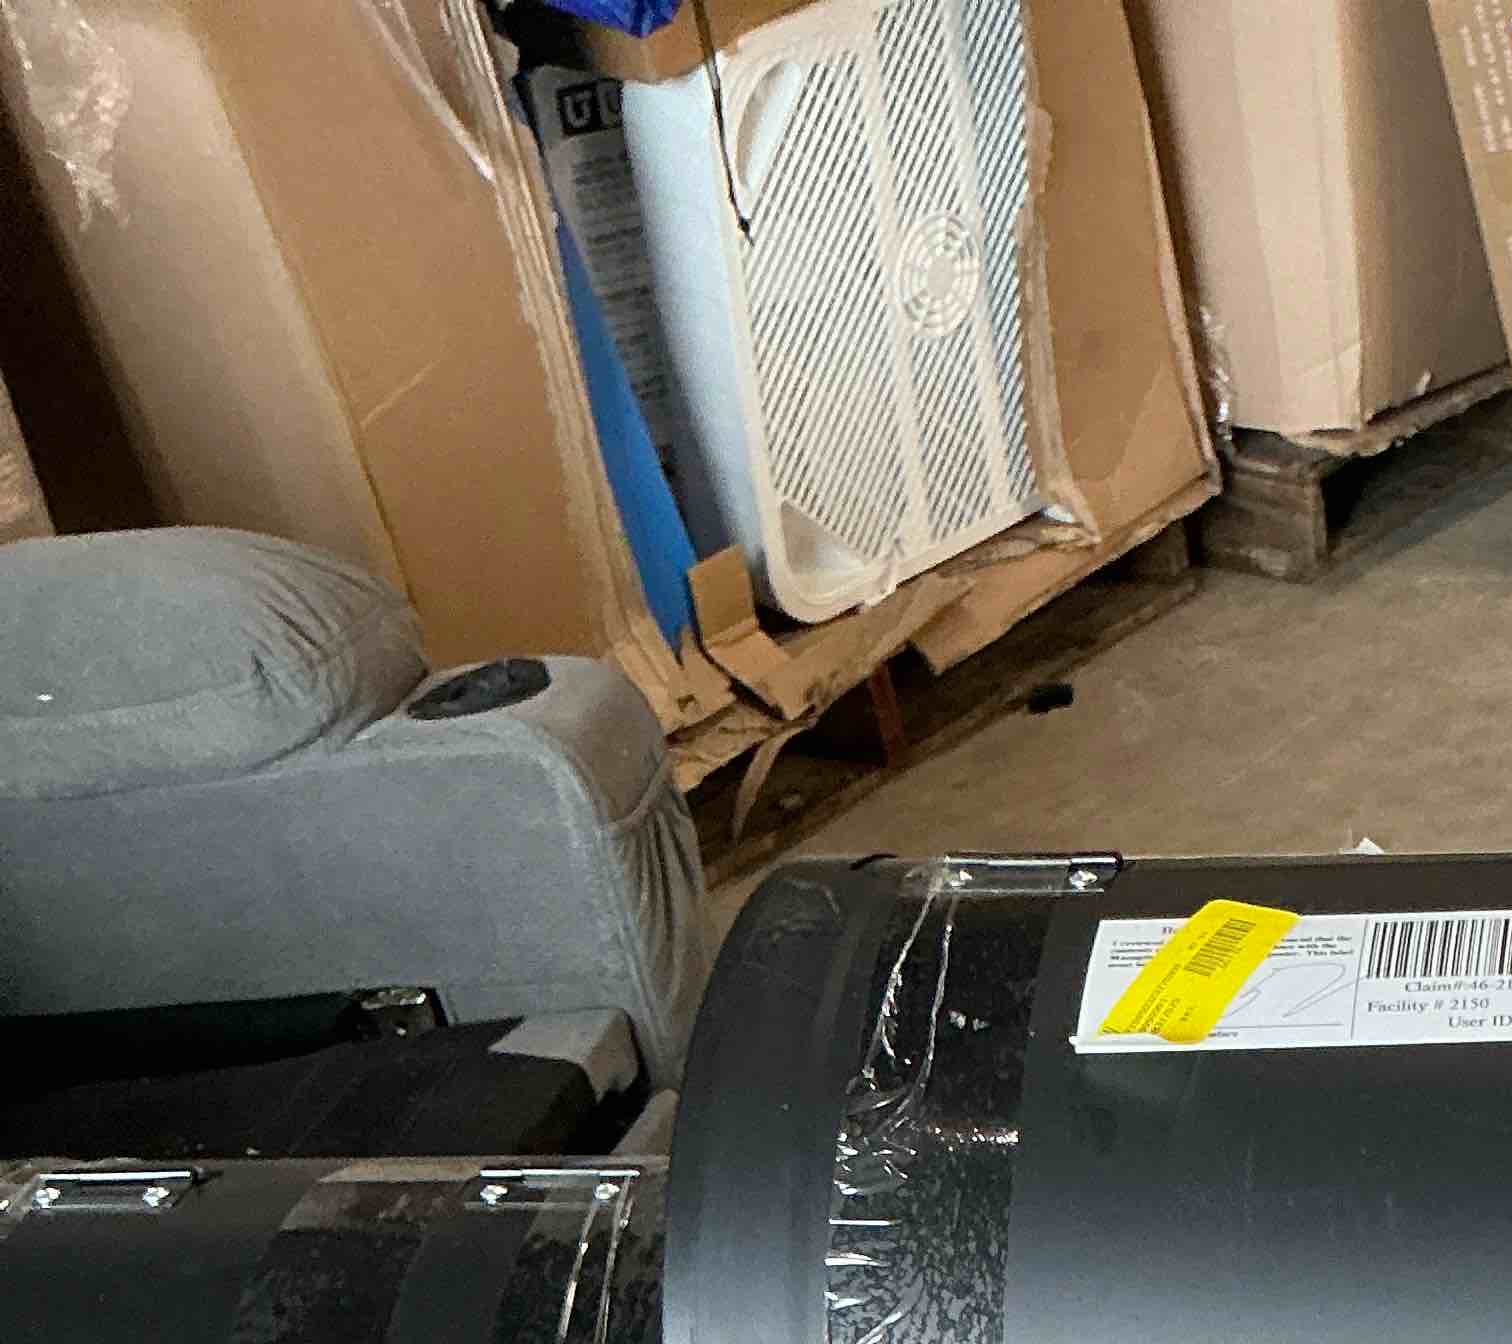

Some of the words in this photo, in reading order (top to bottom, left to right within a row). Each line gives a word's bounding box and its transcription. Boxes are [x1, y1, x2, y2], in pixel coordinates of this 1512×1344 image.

[1367, 999, 1428, 1013] Facility
[1449, 997, 1490, 1010] 2150
[1448, 1015, 1488, 1028] User
[1492, 1014, 1512, 1027] ID
